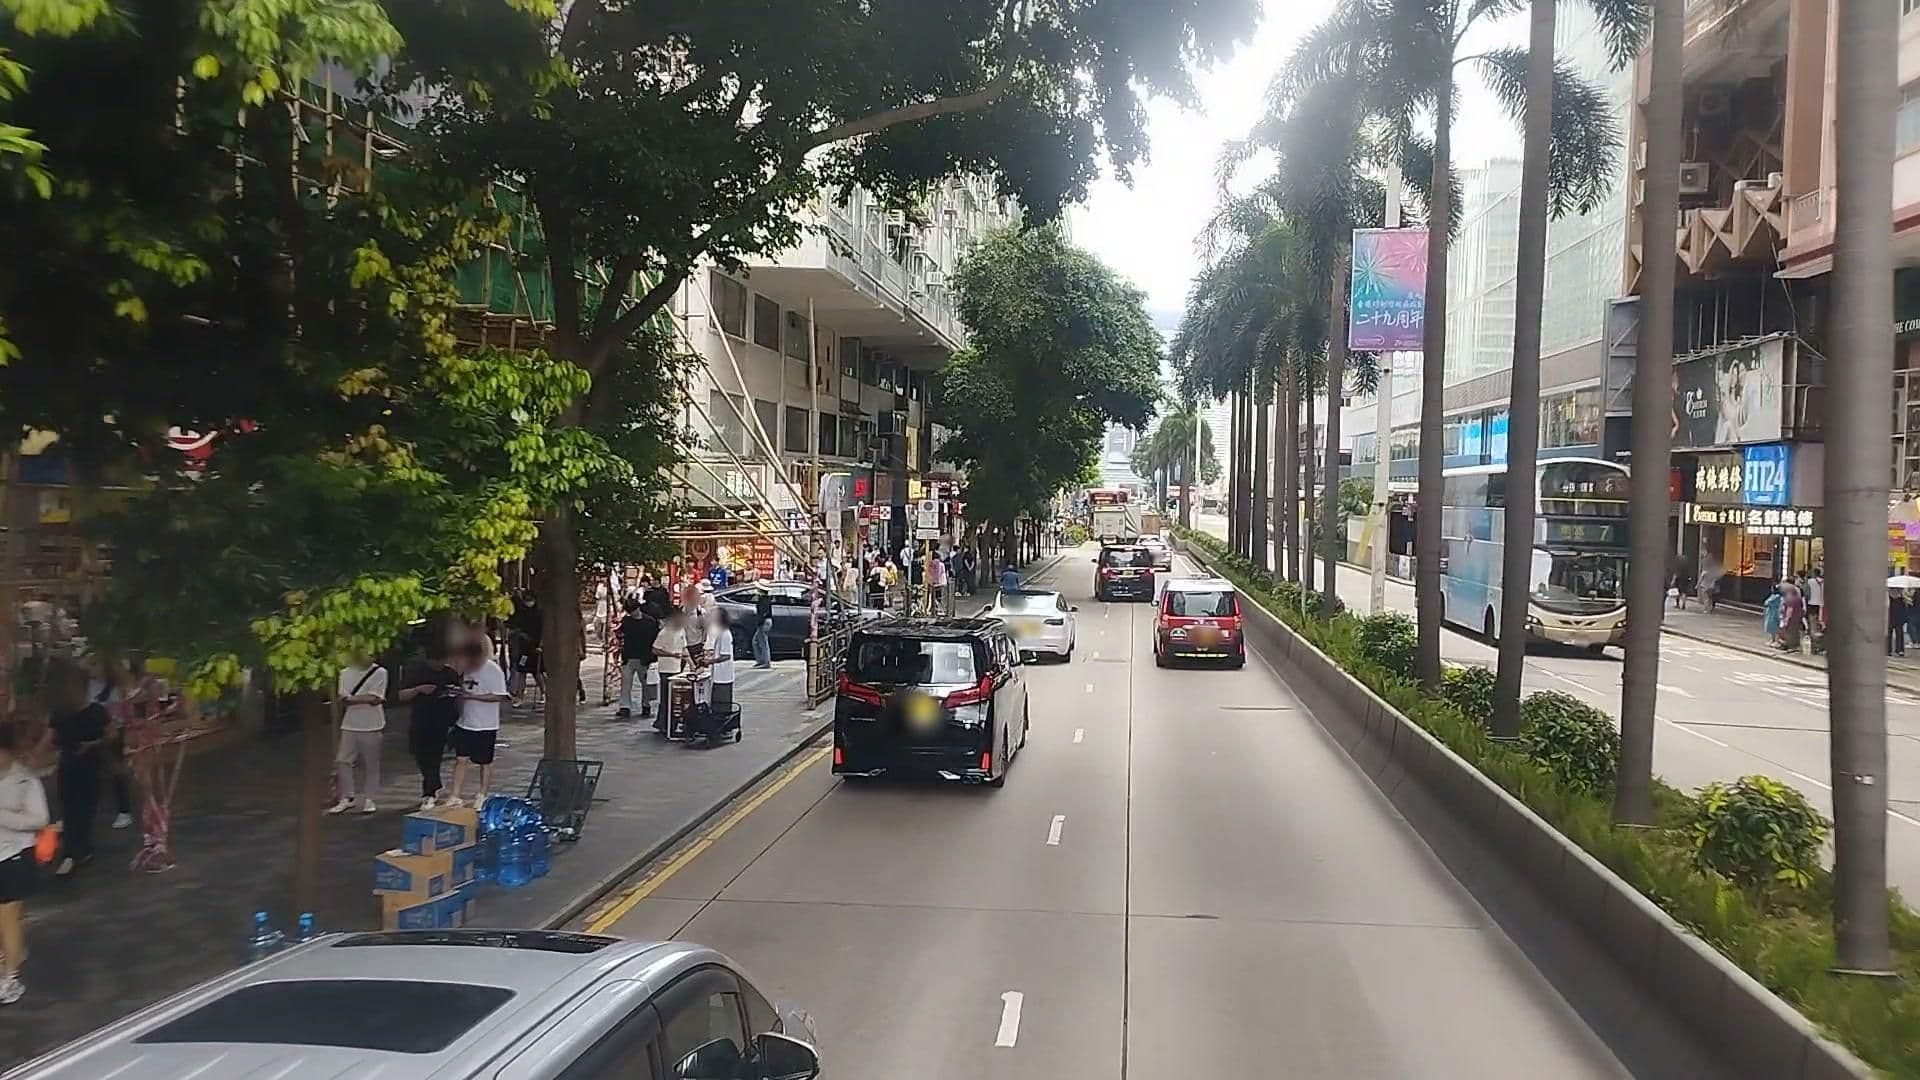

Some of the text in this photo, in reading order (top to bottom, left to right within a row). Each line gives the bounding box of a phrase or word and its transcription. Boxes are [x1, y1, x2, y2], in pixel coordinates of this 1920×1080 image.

[1356, 310, 1423, 328] 二十九周年
[1744, 460, 1786, 492] FIT24
[1600, 525, 1610, 541] 7
